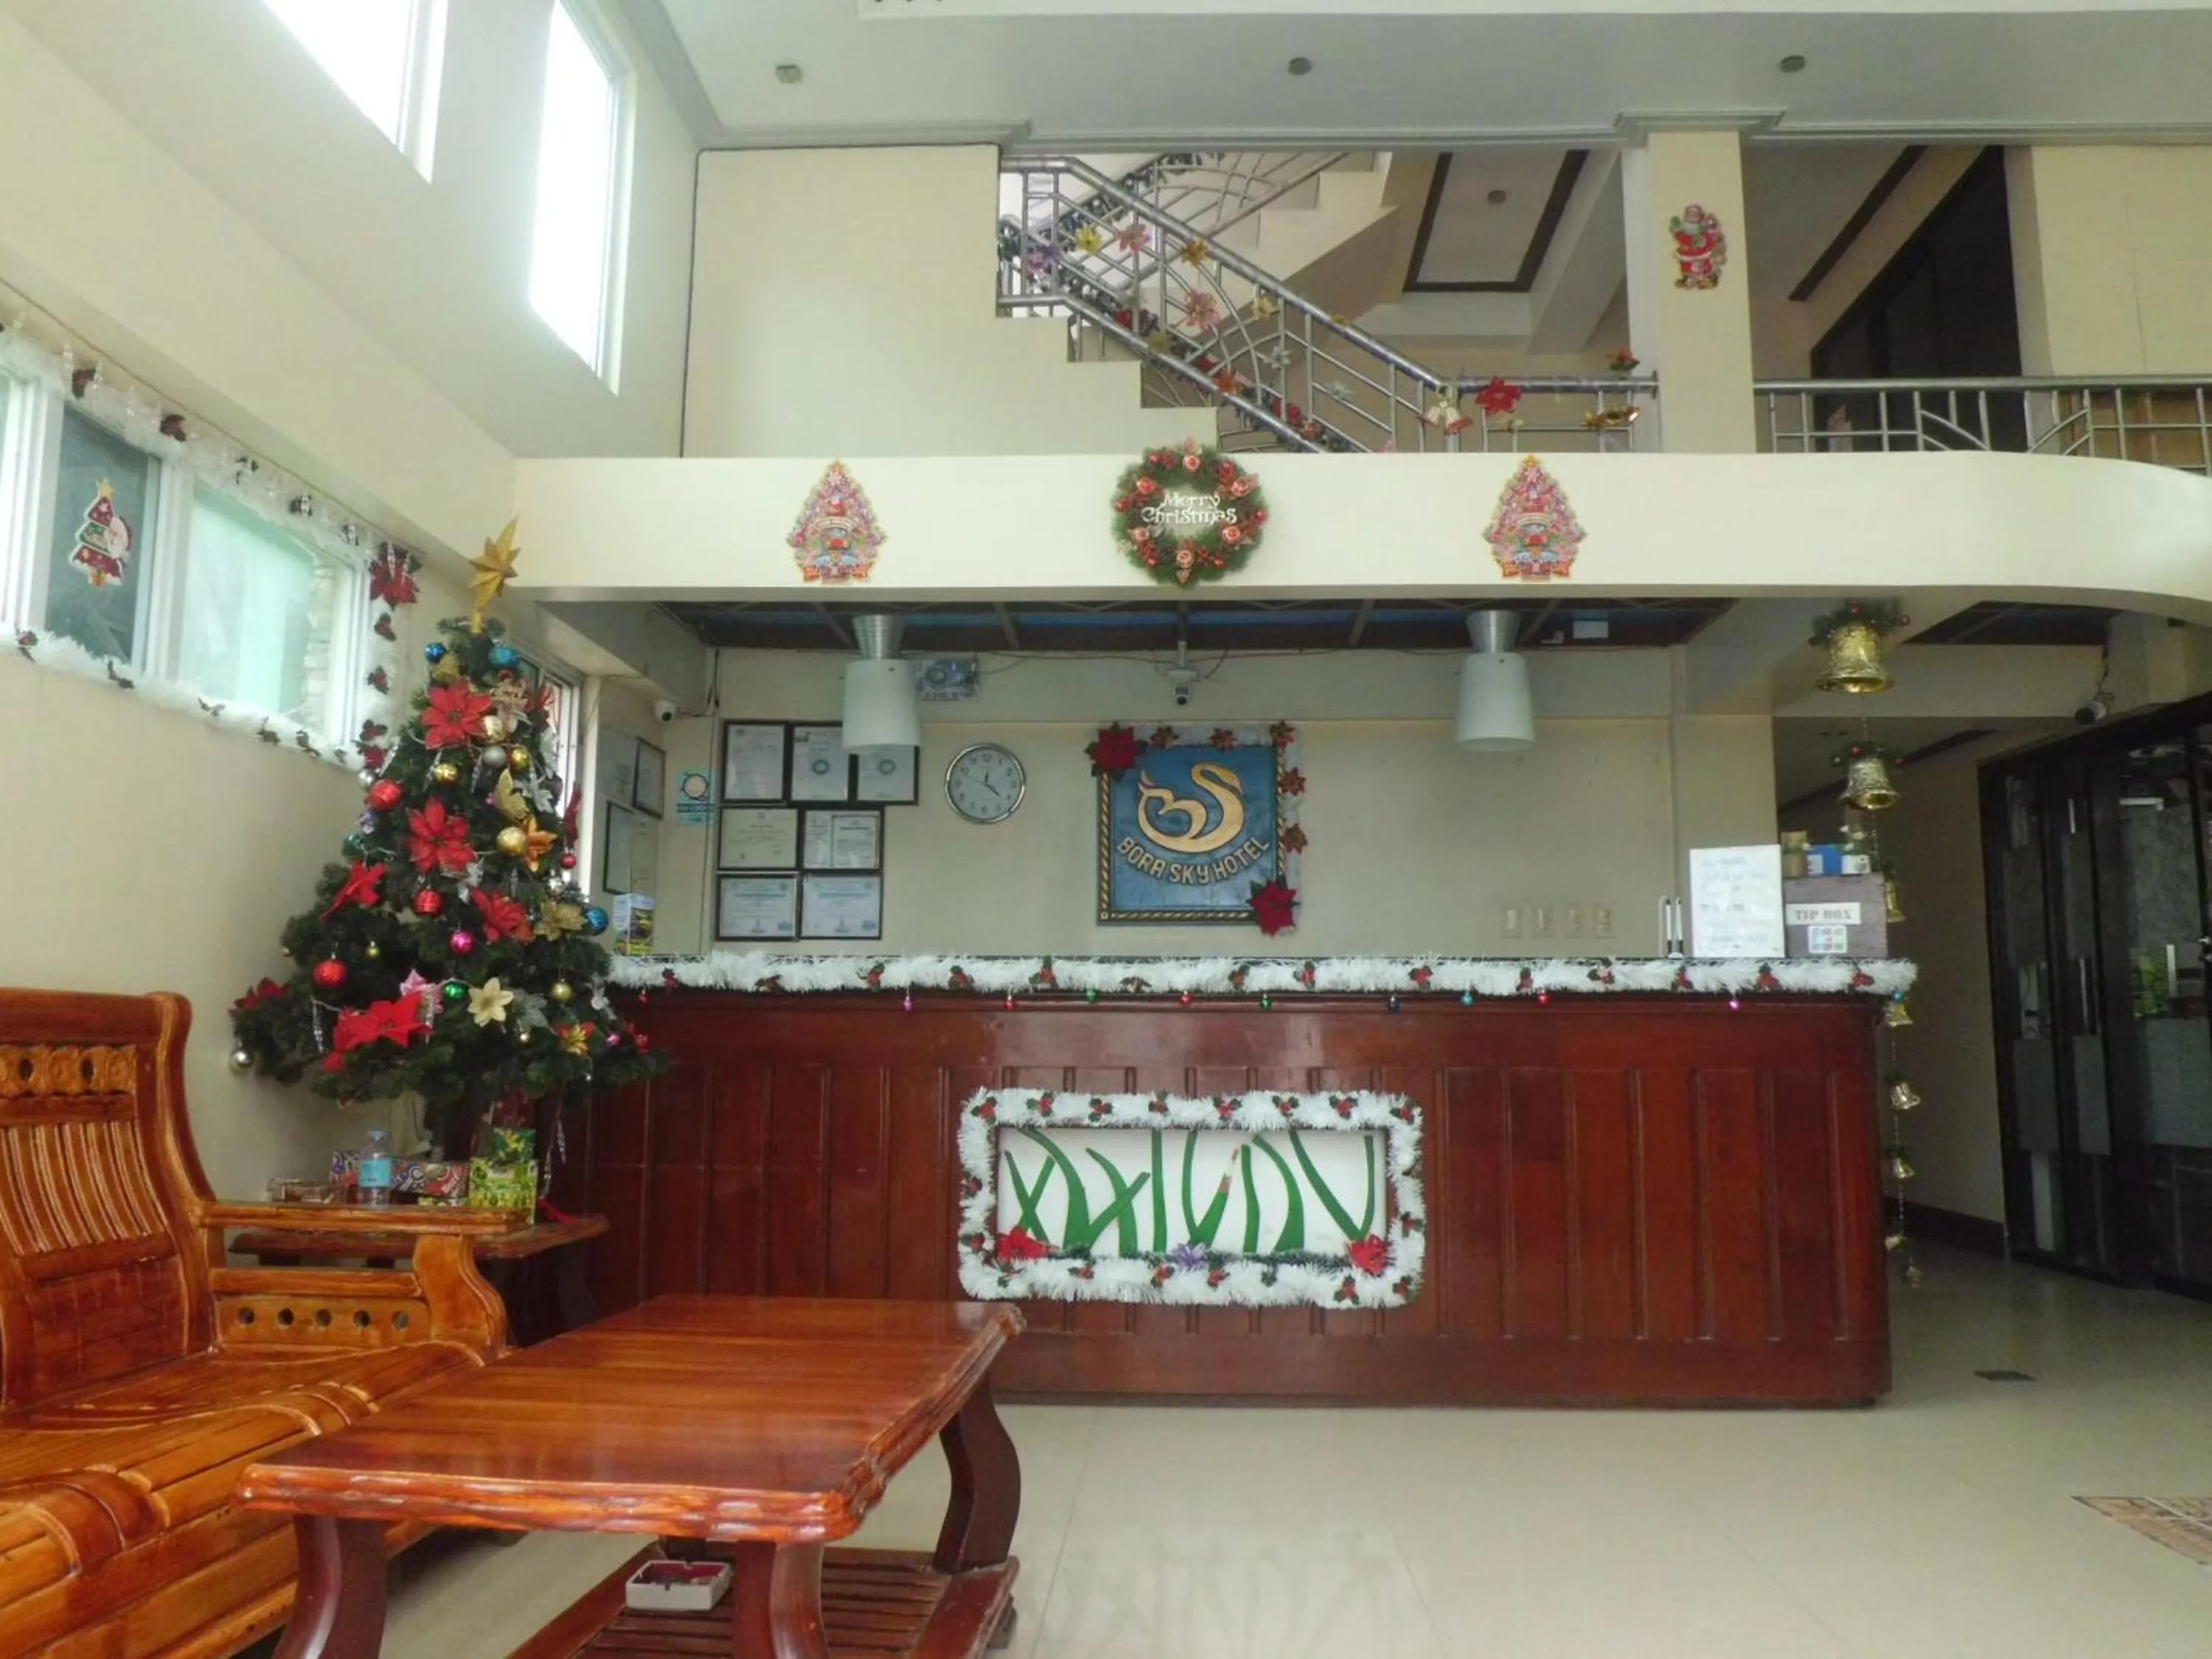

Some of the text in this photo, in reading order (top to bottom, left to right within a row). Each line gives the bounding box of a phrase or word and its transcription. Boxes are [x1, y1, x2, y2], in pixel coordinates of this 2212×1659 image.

[1161, 491, 1221, 509] Merry
[1142, 506, 1237, 526] Christmas
[1116, 837, 1270, 884] BORA SKY HOTEL
[1795, 908, 1851, 921] TIP BOX
